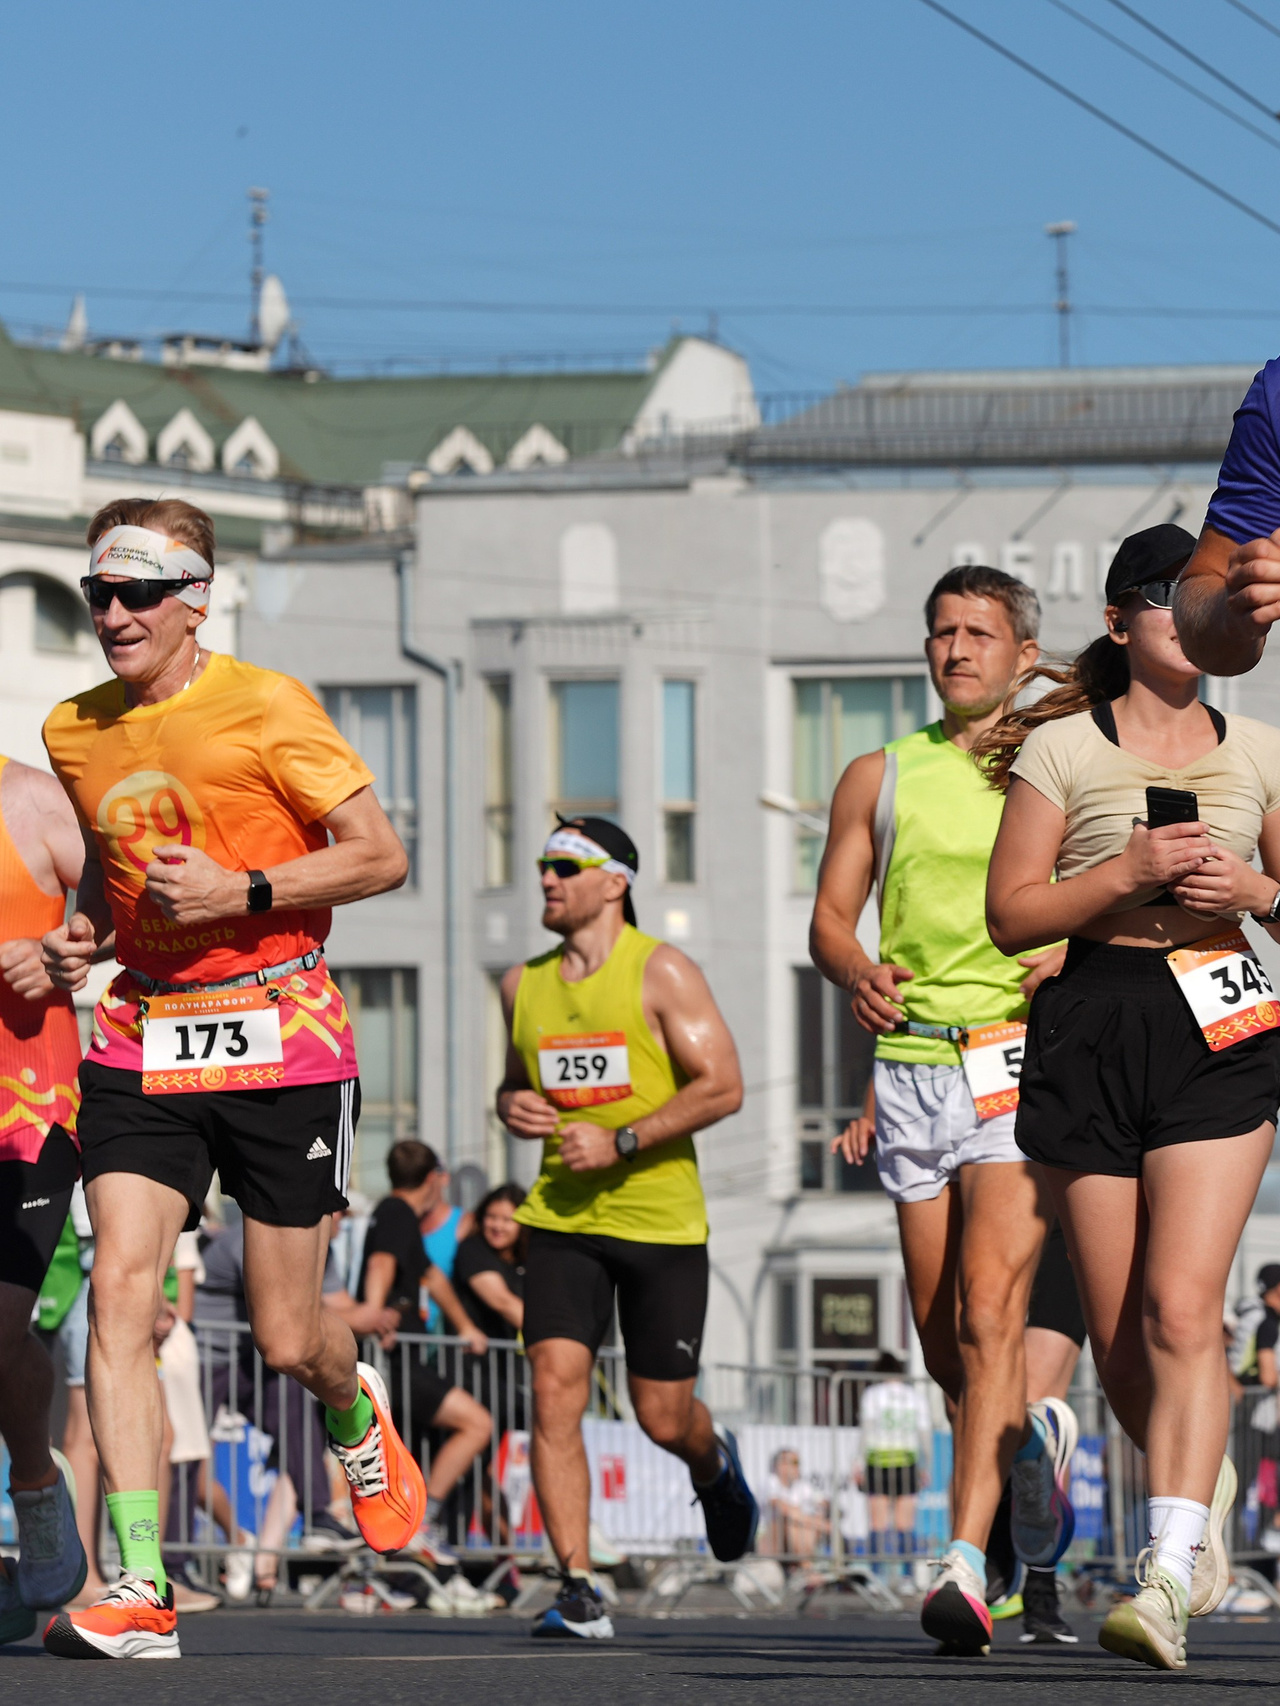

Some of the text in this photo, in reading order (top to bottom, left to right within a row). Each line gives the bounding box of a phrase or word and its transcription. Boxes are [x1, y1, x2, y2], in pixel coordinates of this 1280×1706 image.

[107, 552, 164, 571] ПОЛУМАРАФОН
[109, 546, 149, 557] ВЕСЕННИЙ
[1210, 957, 1273, 1005] 345
[165, 997, 246, 1011] ПОЛУМАРАФОН
[175, 1020, 249, 1061] 173
[557, 1055, 607, 1081] 259
[1003, 1046, 1024, 1079] 5
